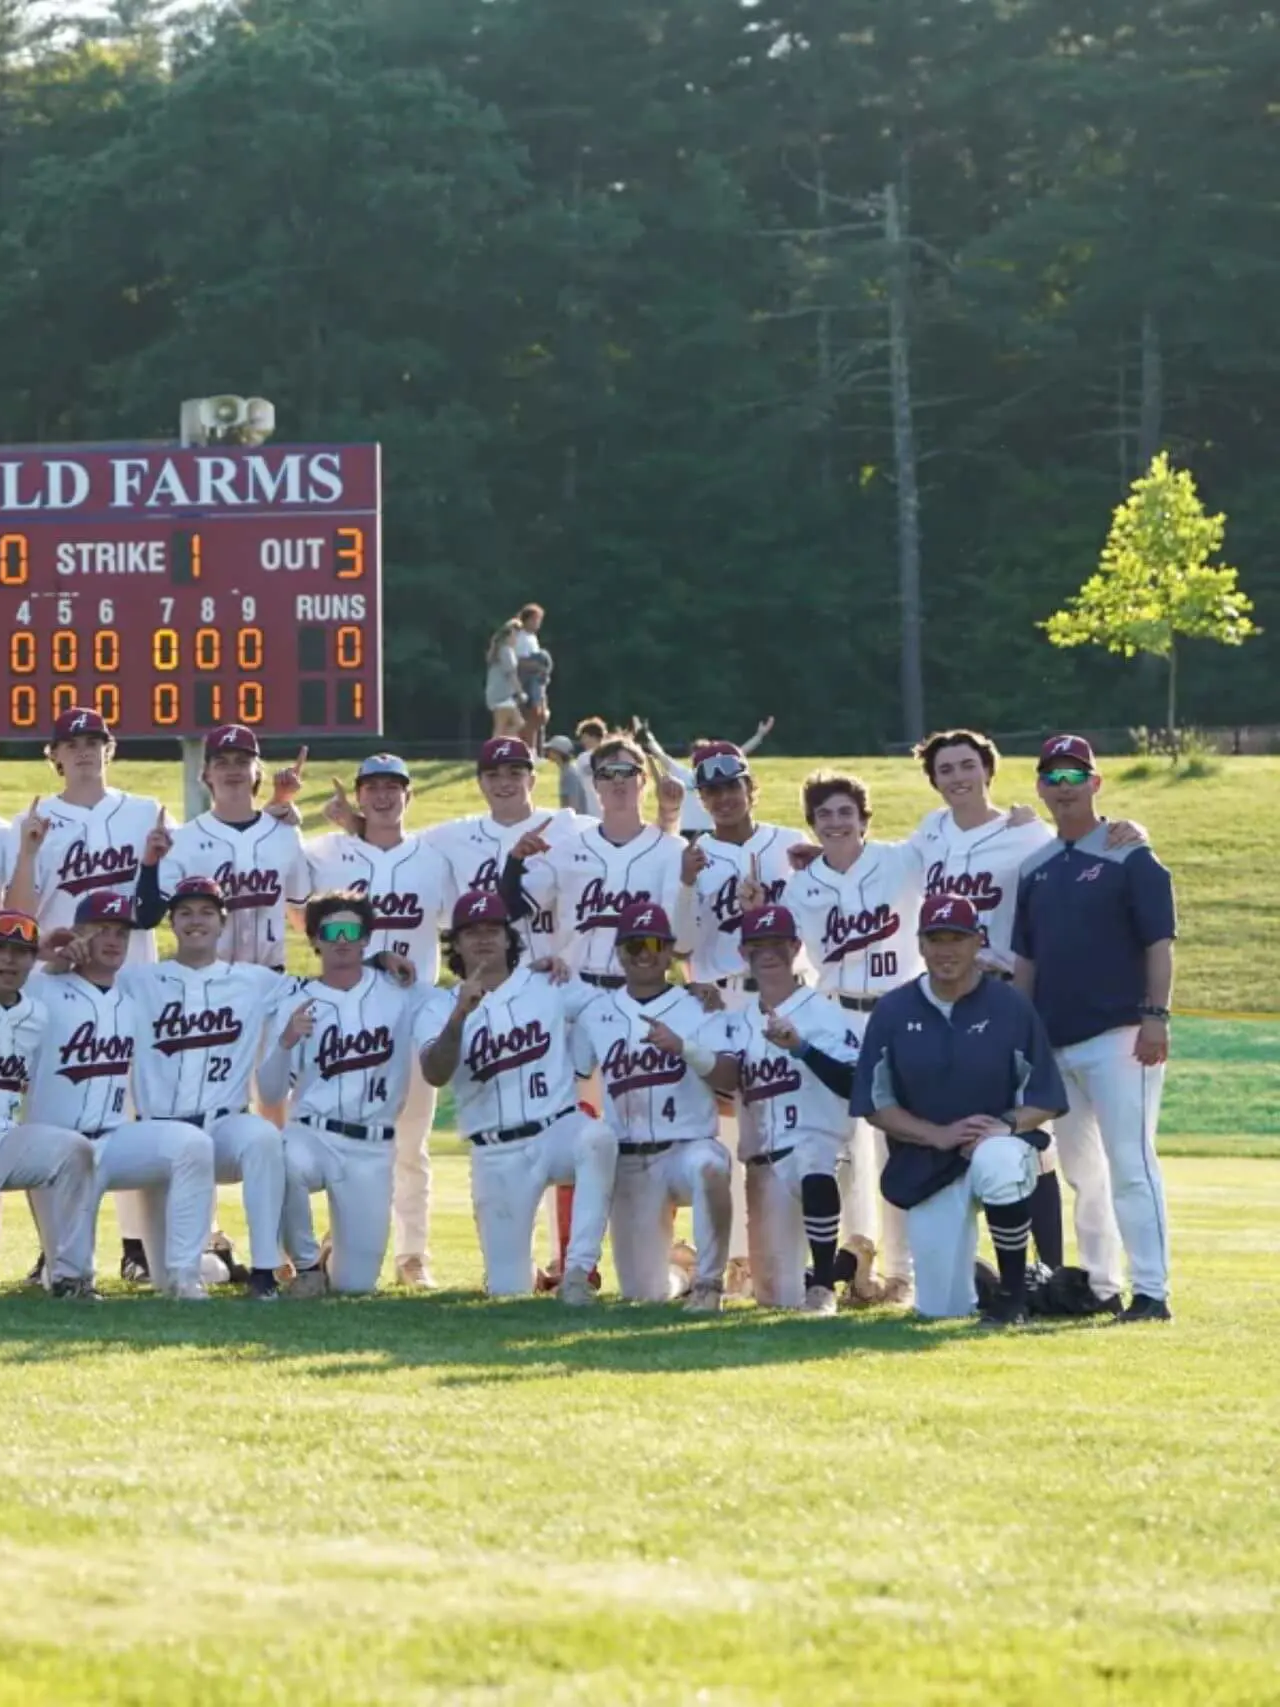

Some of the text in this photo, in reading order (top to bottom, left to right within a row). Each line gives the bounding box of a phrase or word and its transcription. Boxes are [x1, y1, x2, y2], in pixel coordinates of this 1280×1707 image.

[109, 453, 343, 507] FARMS
[56, 541, 166, 575] STRIKE
[192, 533, 201, 579] 1
[260, 537, 325, 571] OUT
[337, 527, 364, 579] 3
[16, 600, 31, 626] 4
[57, 599, 72, 625] 5
[98, 598, 114, 625] 6
[160, 597, 174, 624] 7
[200, 597, 215, 623] 8
[242, 596, 256, 622] 9
[296, 594, 366, 621] RUNS
[11, 631, 35, 673] 0
[53, 630, 77, 672] 0
[94, 630, 119, 671] 0
[154, 629, 178, 670] 0
[196, 628, 220, 669] 0
[238, 628, 262, 669] 0
[337, 626, 361, 668] 0
[11, 685, 35, 726] 0
[154, 683, 178, 724] 0
[239, 682, 263, 723] 0
[57, 839, 138, 881] Avon
[214, 861, 281, 896] Avon
[926, 860, 1003, 897] Avon
[576, 878, 651, 920] Avon
[531, 910, 554, 934] 20
[822, 903, 898, 946] Avon
[152, 1001, 242, 1039] Avon
[59, 1020, 134, 1065] Avon
[314, 1025, 394, 1074] Avon
[465, 1020, 551, 1074] Avon
[602, 1038, 687, 1079] Avon
[207, 1057, 231, 1083] 22
[529, 1072, 548, 1100] 16
[368, 1077, 387, 1103] 14
[661, 1096, 677, 1123] 4
[784, 1104, 798, 1129] 9
